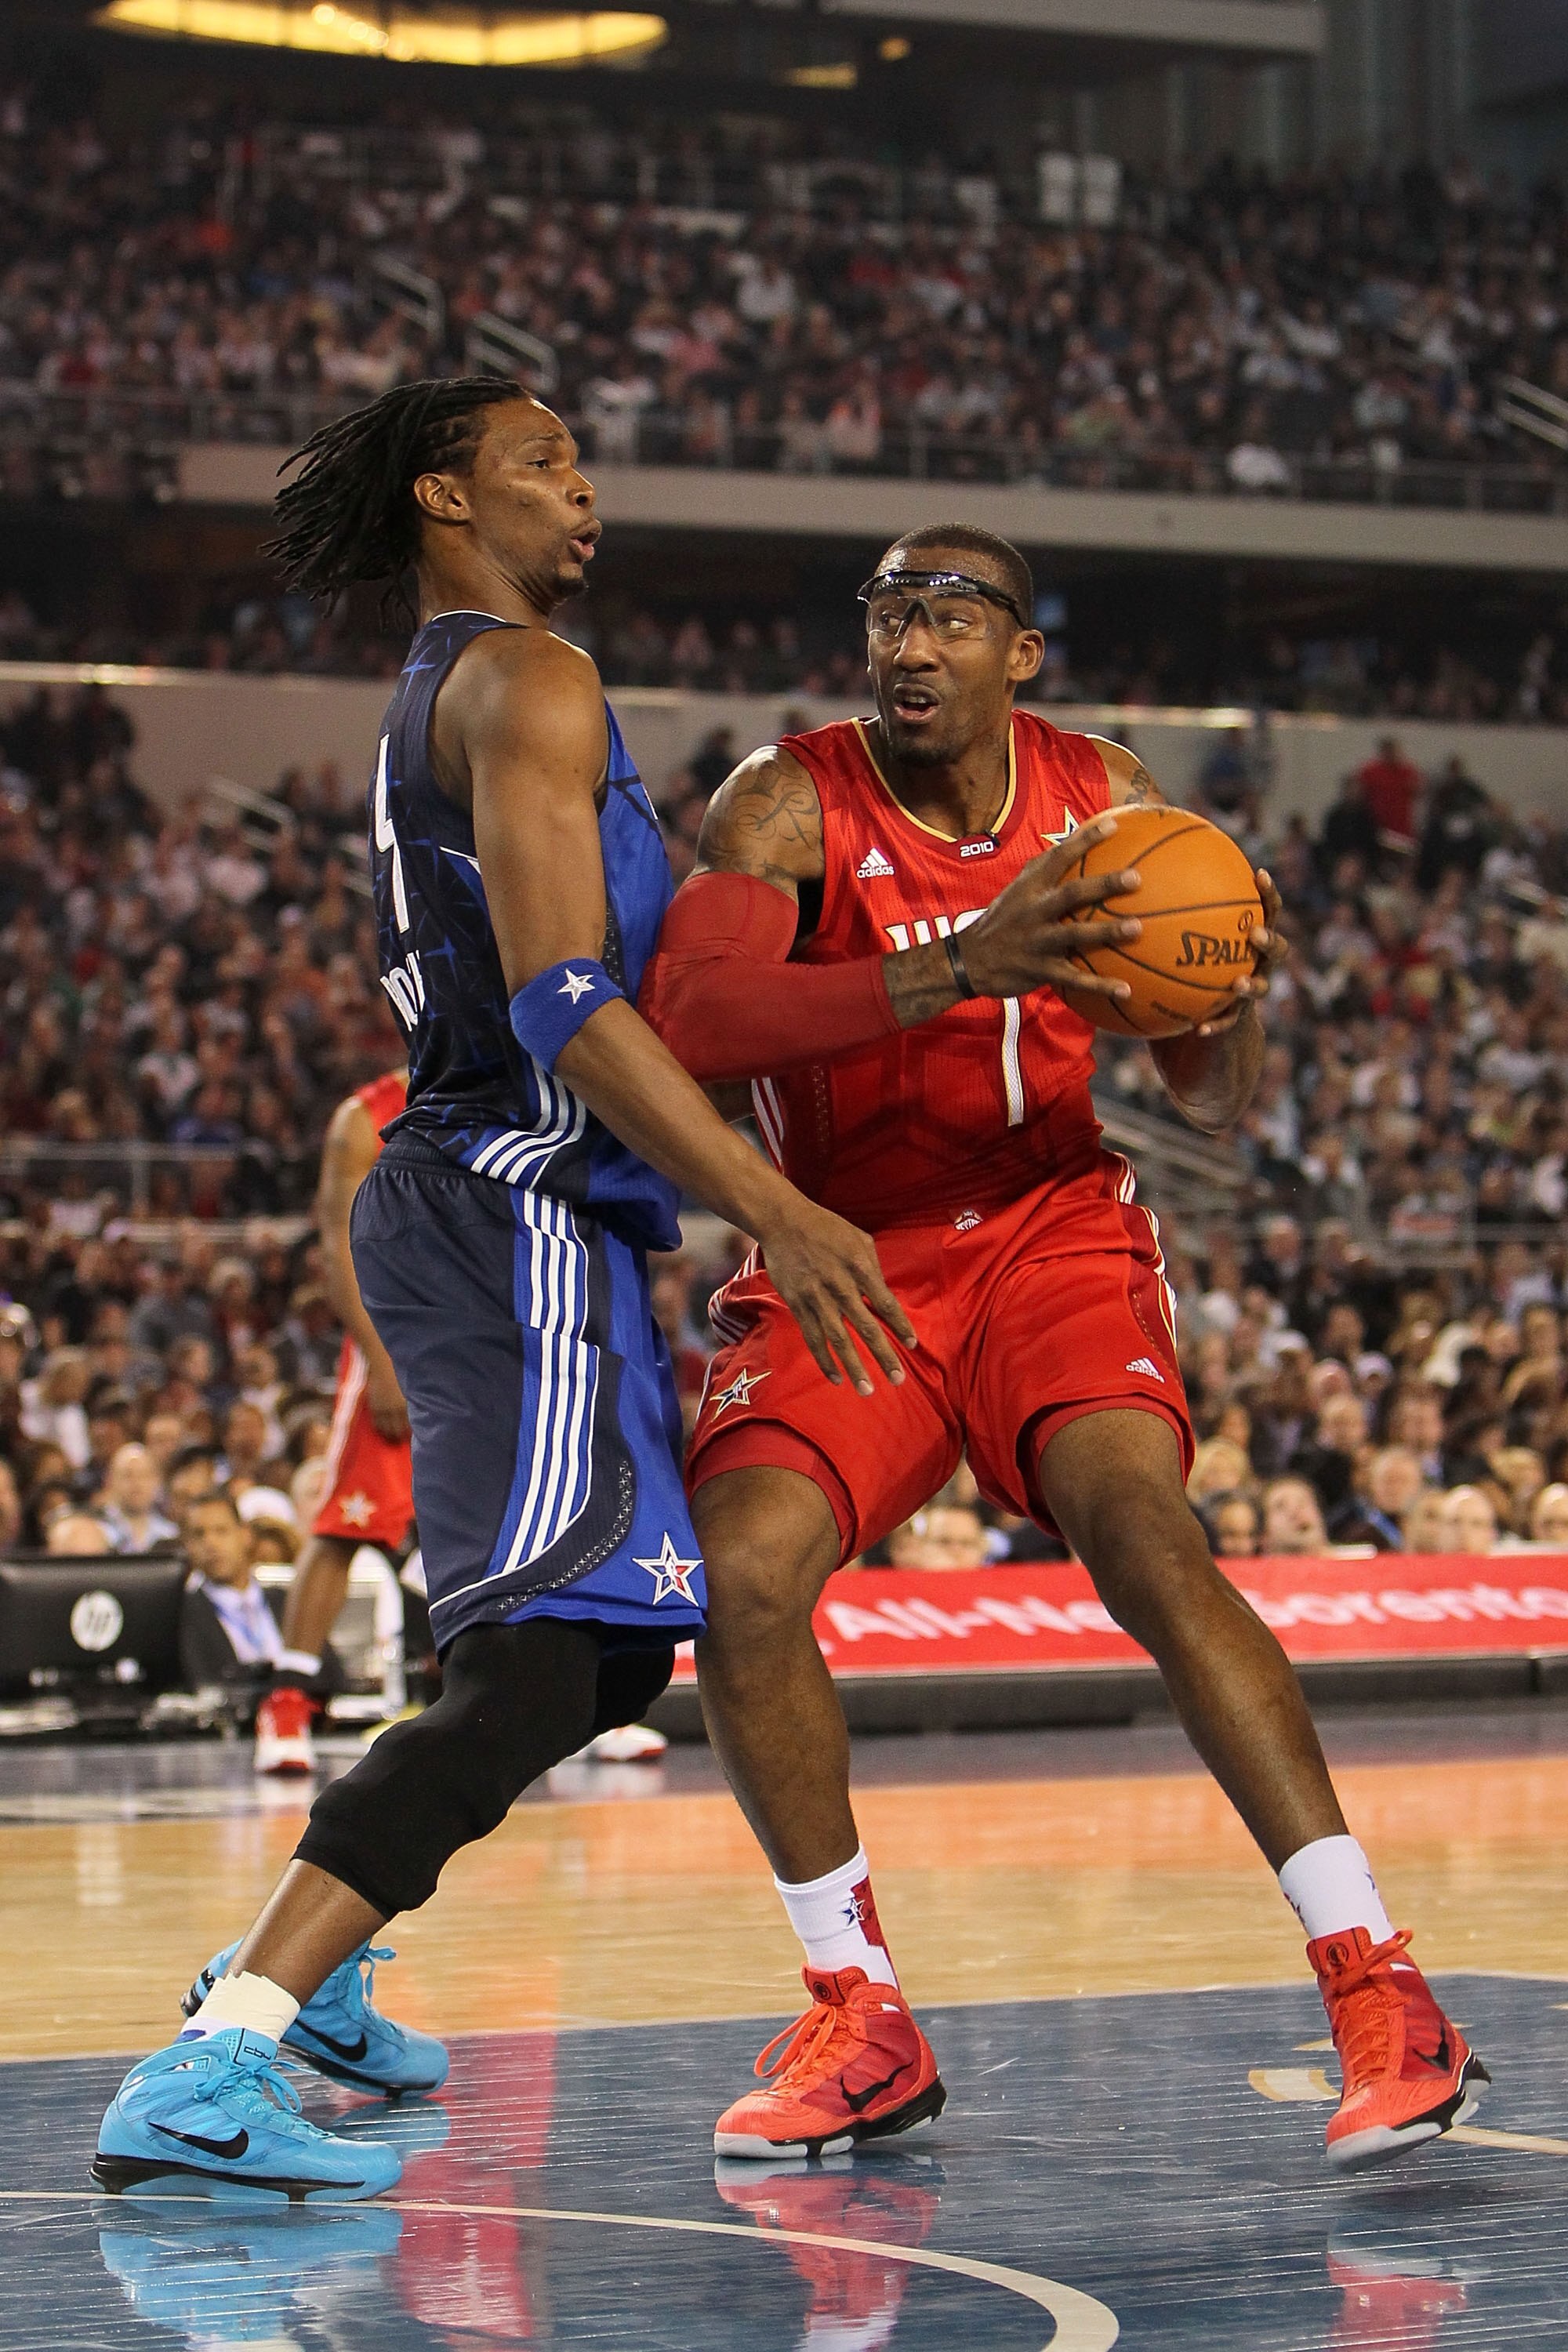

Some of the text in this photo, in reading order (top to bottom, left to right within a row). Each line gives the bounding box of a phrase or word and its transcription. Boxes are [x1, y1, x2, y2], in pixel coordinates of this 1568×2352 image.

[960, 840, 994, 858] 2010
[856, 865, 895, 879] adidas
[823, 1594, 1125, 1642] All-Ne
